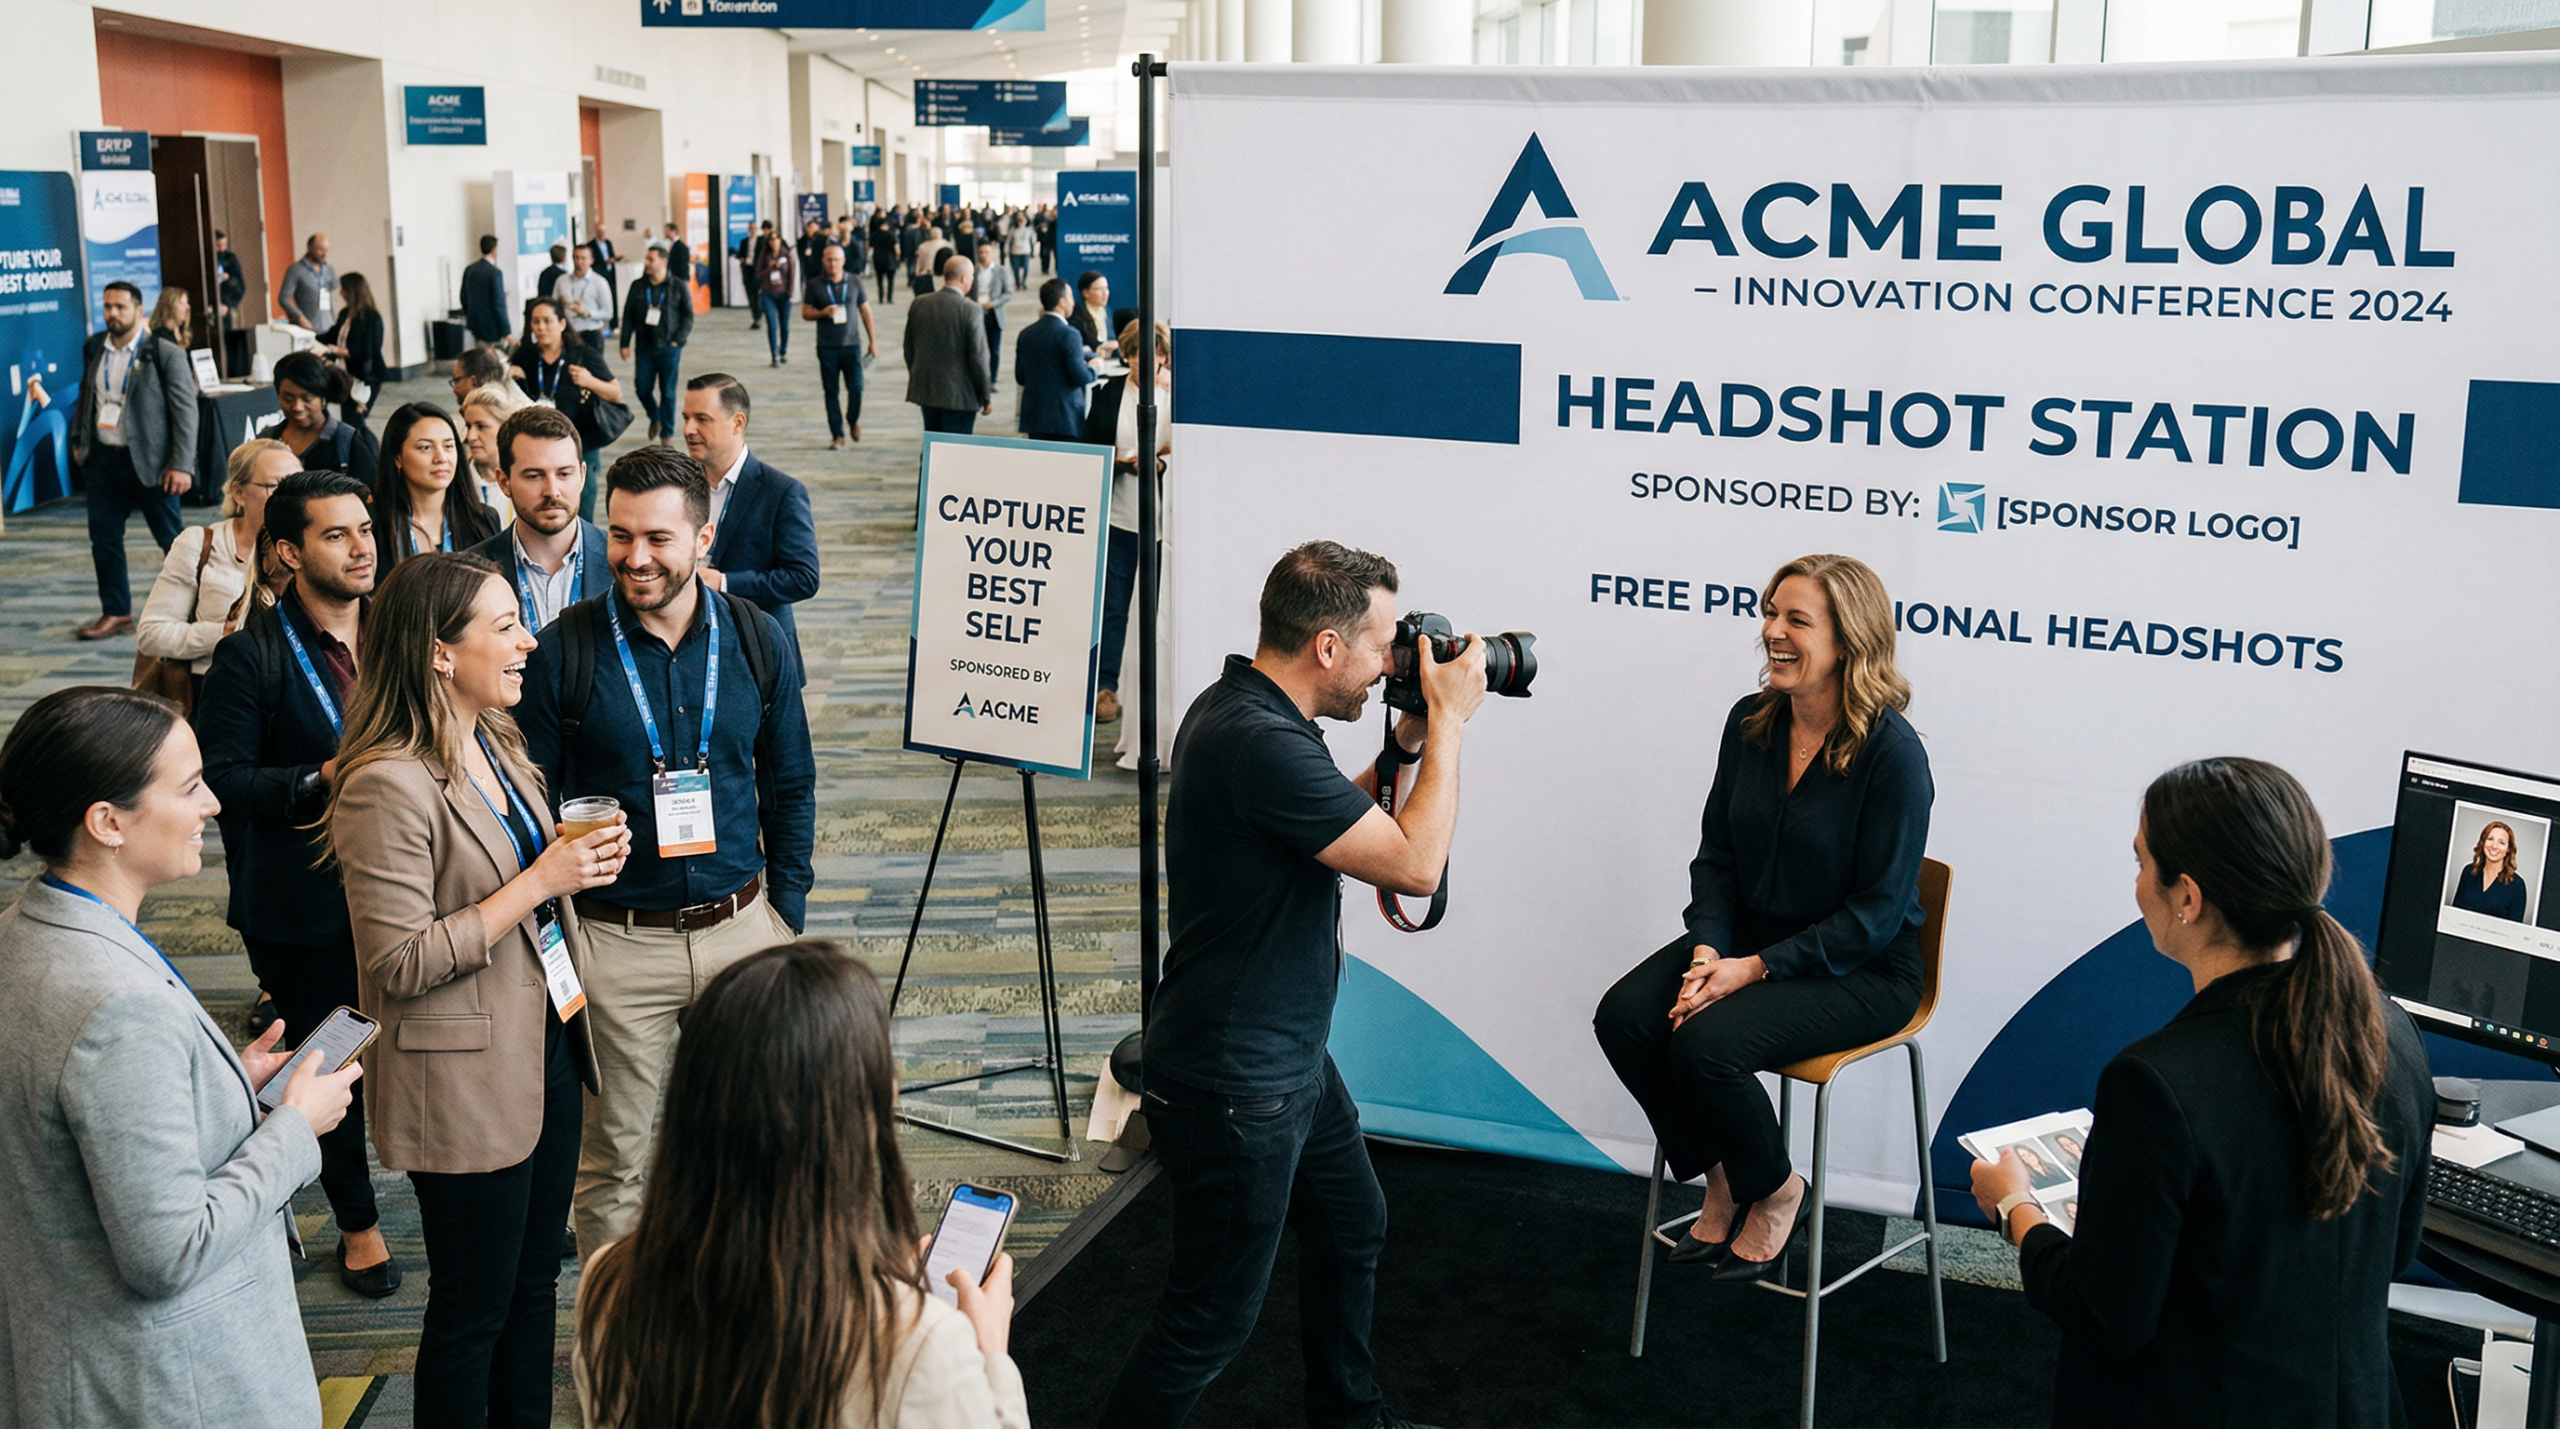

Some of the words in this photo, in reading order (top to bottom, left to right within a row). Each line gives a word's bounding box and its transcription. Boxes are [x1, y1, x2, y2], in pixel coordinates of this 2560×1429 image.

[427, 94, 462, 107] ACME
[1647, 181, 2003, 262] ACME
[2043, 183, 2456, 268] GLOBAL
[31, 247, 63, 269] YOUR
[1734, 276, 2012, 313] INNOVATION
[2030, 283, 2335, 320] CONFERENCE
[2348, 289, 2453, 323] 2024
[1557, 374, 2006, 452] HEADSHOT
[2028, 397, 2416, 475] STATION
[938, 494, 1086, 535] CAPTURE
[1630, 472, 1853, 513] SPONSORED
[1865, 488, 1920, 519] BY:
[1997, 496, 2177, 535] [SPONSOR
[2188, 510, 2301, 550] LOGO]
[964, 534, 1053, 571] YOUR
[967, 572, 1047, 607] BEST
[965, 610, 1042, 645] SELF
[1590, 573, 1690, 612] FREE
[1704, 583, 2033, 644] PRIONAL
[2047, 614, 2344, 673] HEADSHOTS
[950, 658, 1031, 682] SPONSORED
[1033, 669, 1052, 684] BY
[978, 699, 1040, 725] ACME
